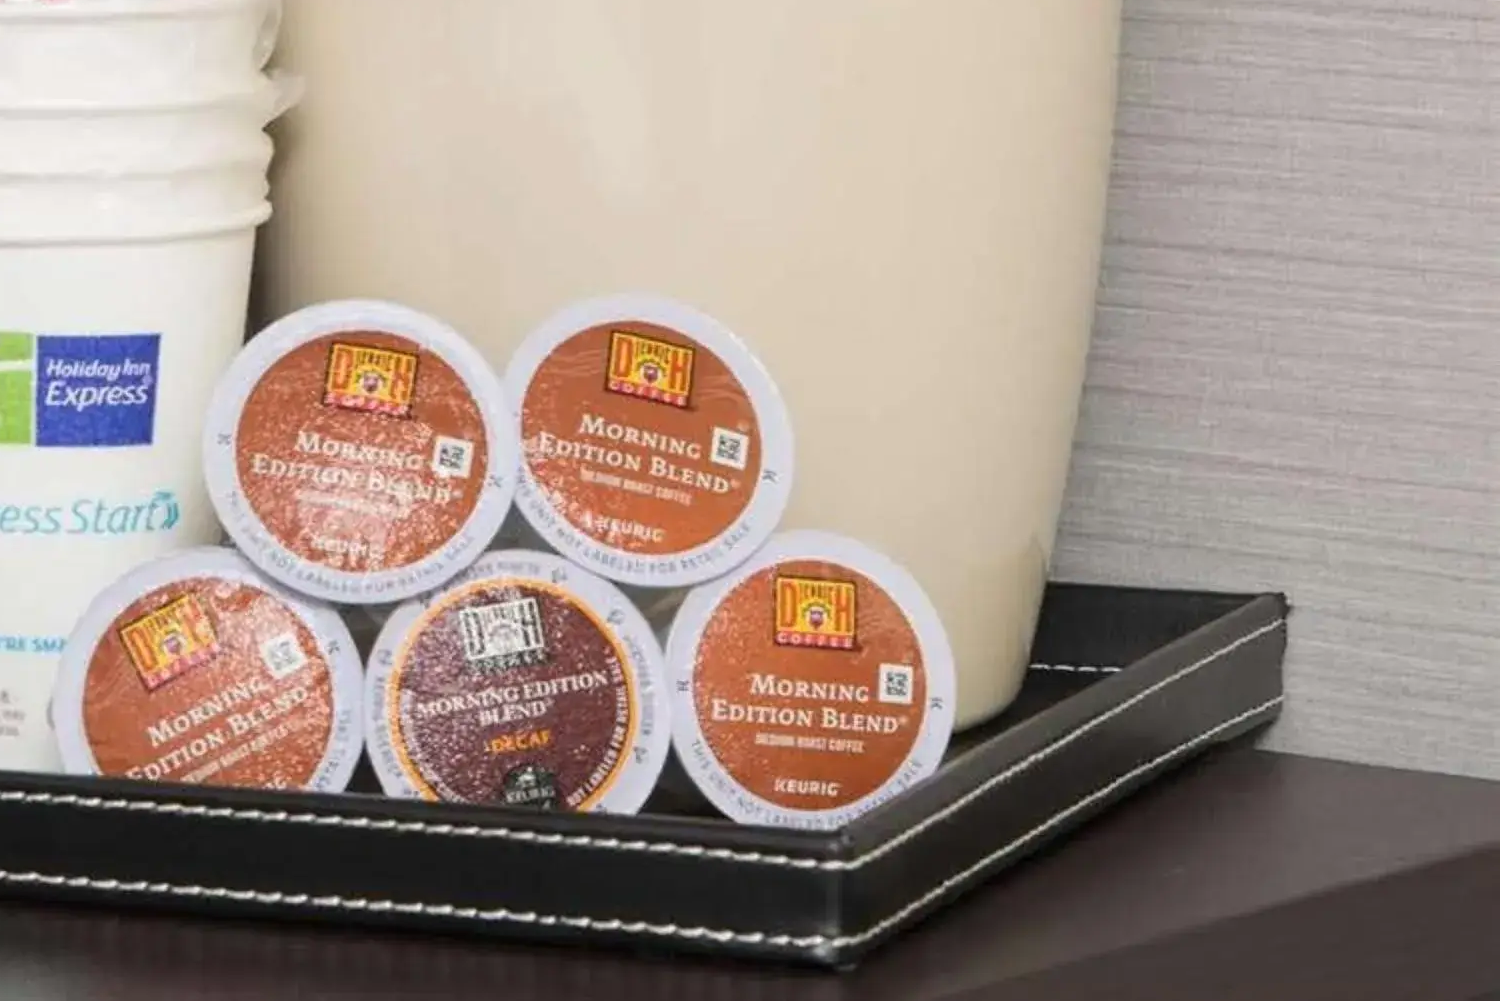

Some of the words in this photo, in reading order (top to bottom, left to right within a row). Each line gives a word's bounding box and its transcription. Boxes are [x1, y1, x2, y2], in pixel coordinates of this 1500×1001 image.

[46, 357, 121, 382] Holiday
[121, 358, 152, 377] Inn
[773, 777, 841, 797] KEURIG
